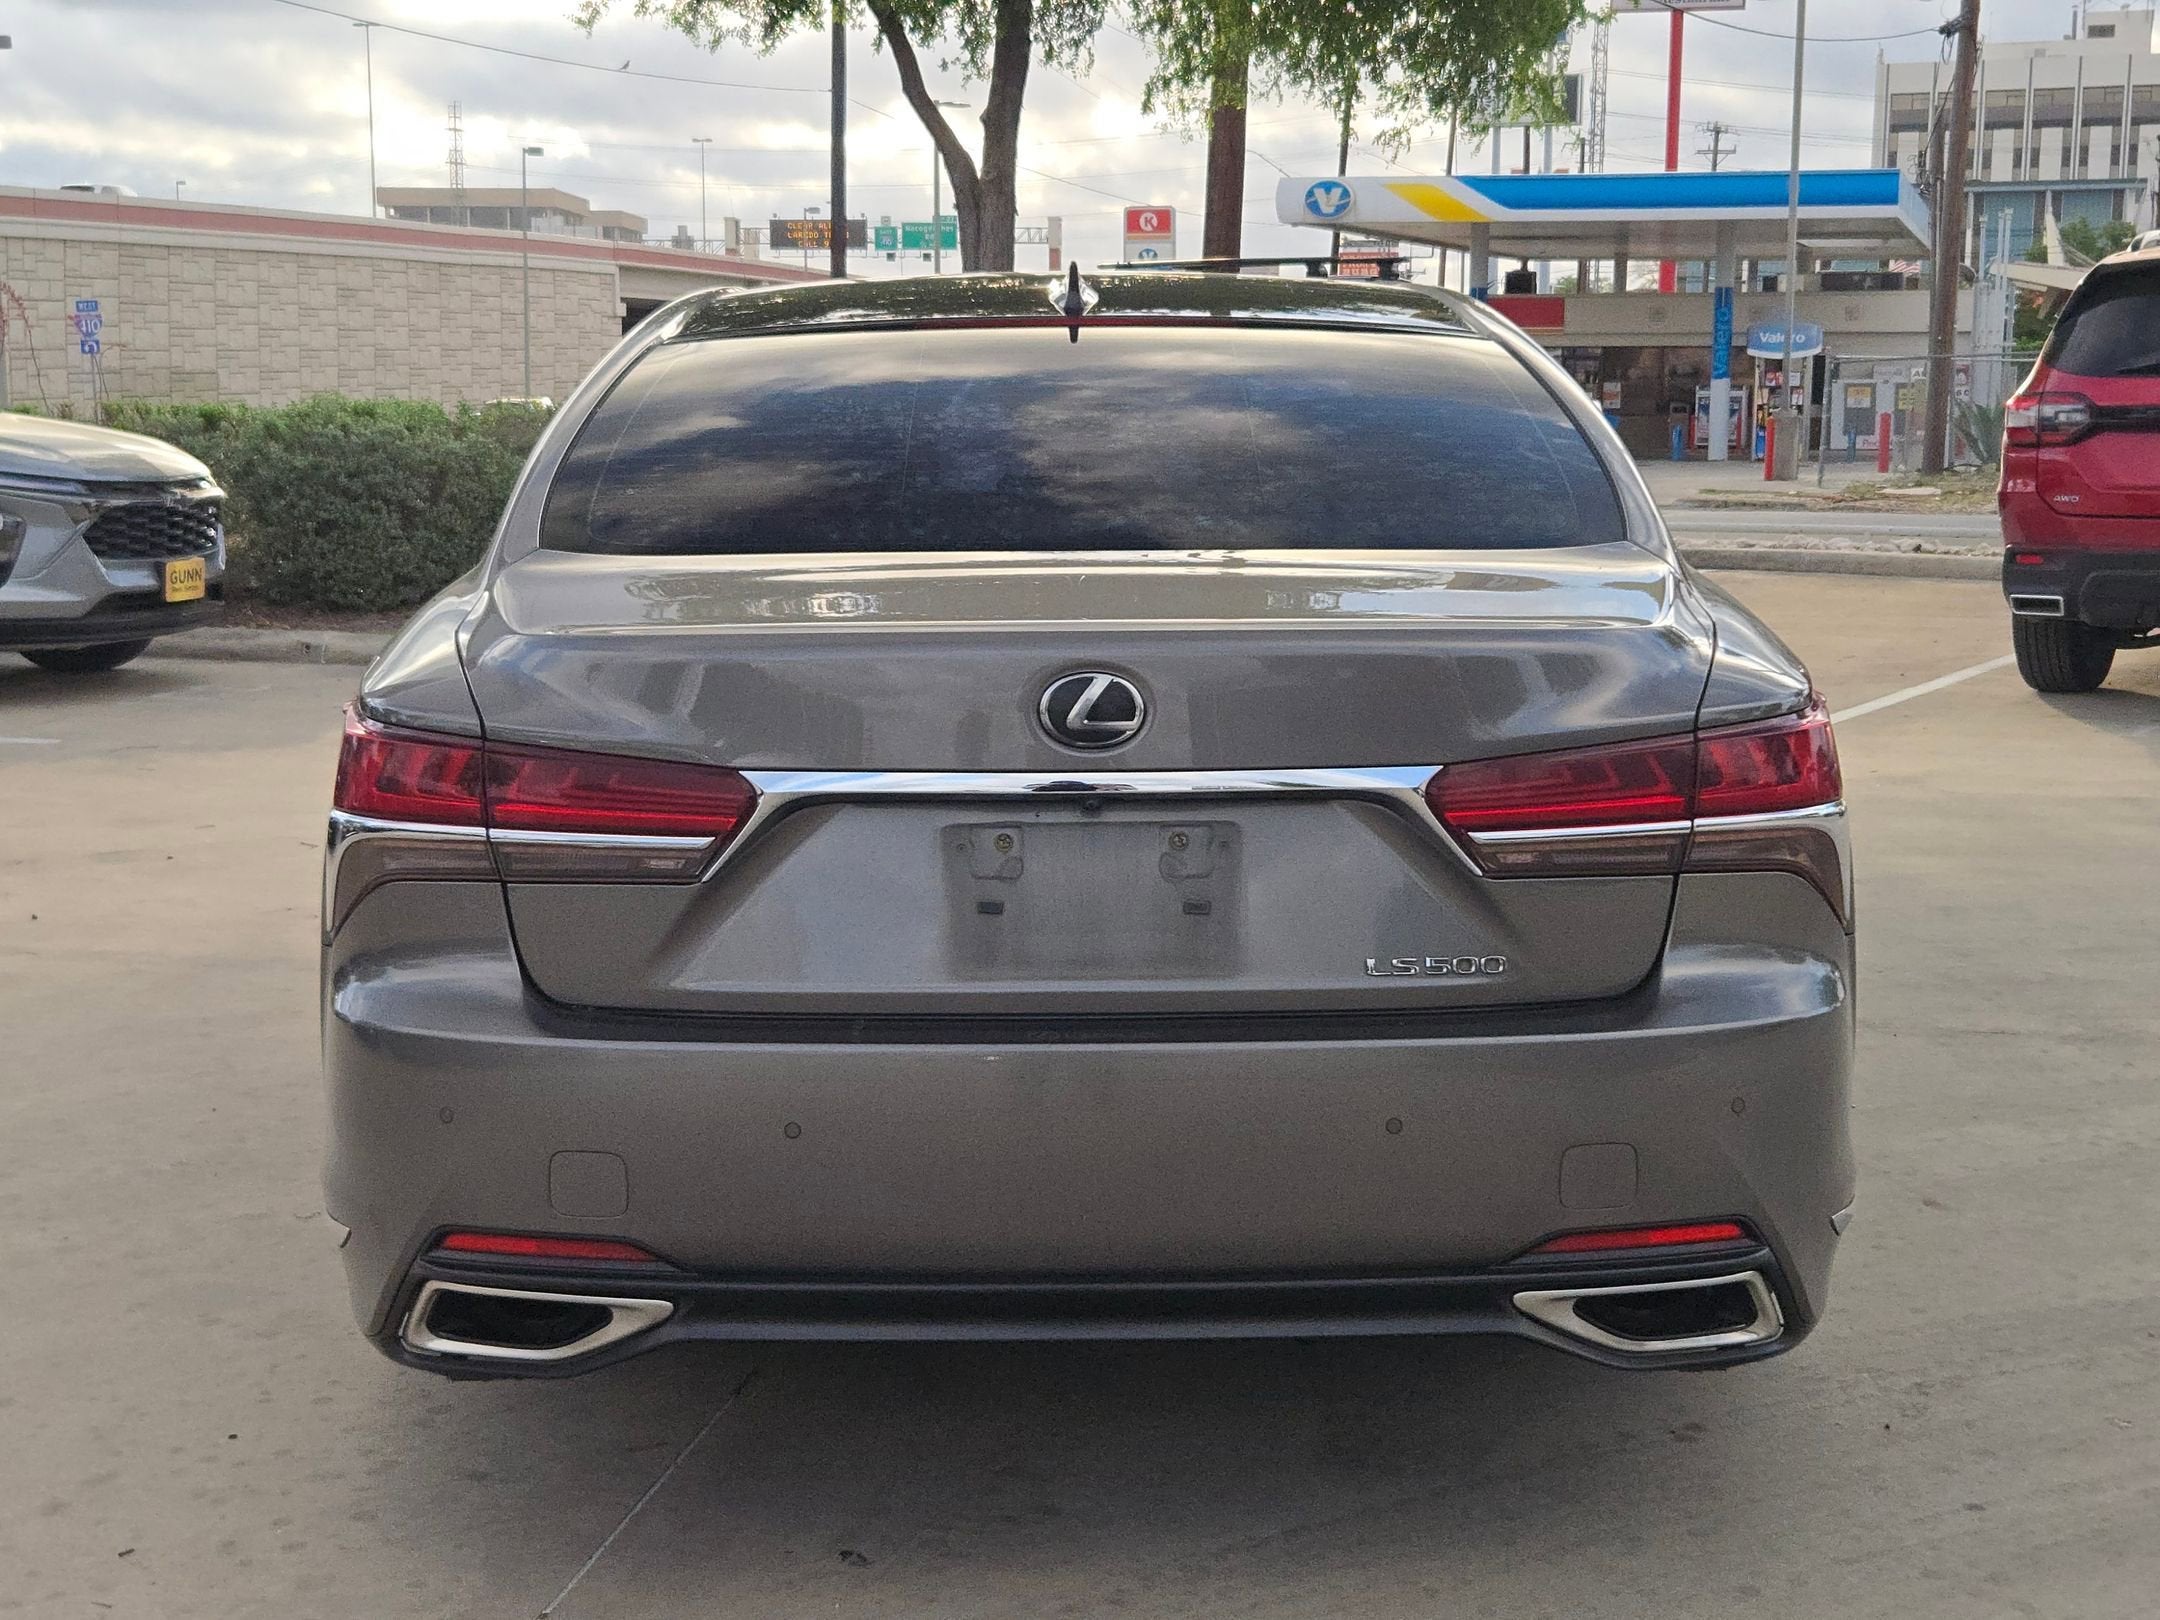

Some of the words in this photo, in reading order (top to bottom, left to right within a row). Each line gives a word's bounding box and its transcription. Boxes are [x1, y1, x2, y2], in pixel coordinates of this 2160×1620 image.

[787, 231, 819, 239] LAREDO
[80, 319, 100, 334] 410
[2053, 495, 2080, 503] AWD
[169, 567, 203, 585] GUNN
[1425, 954, 1508, 976] 500
